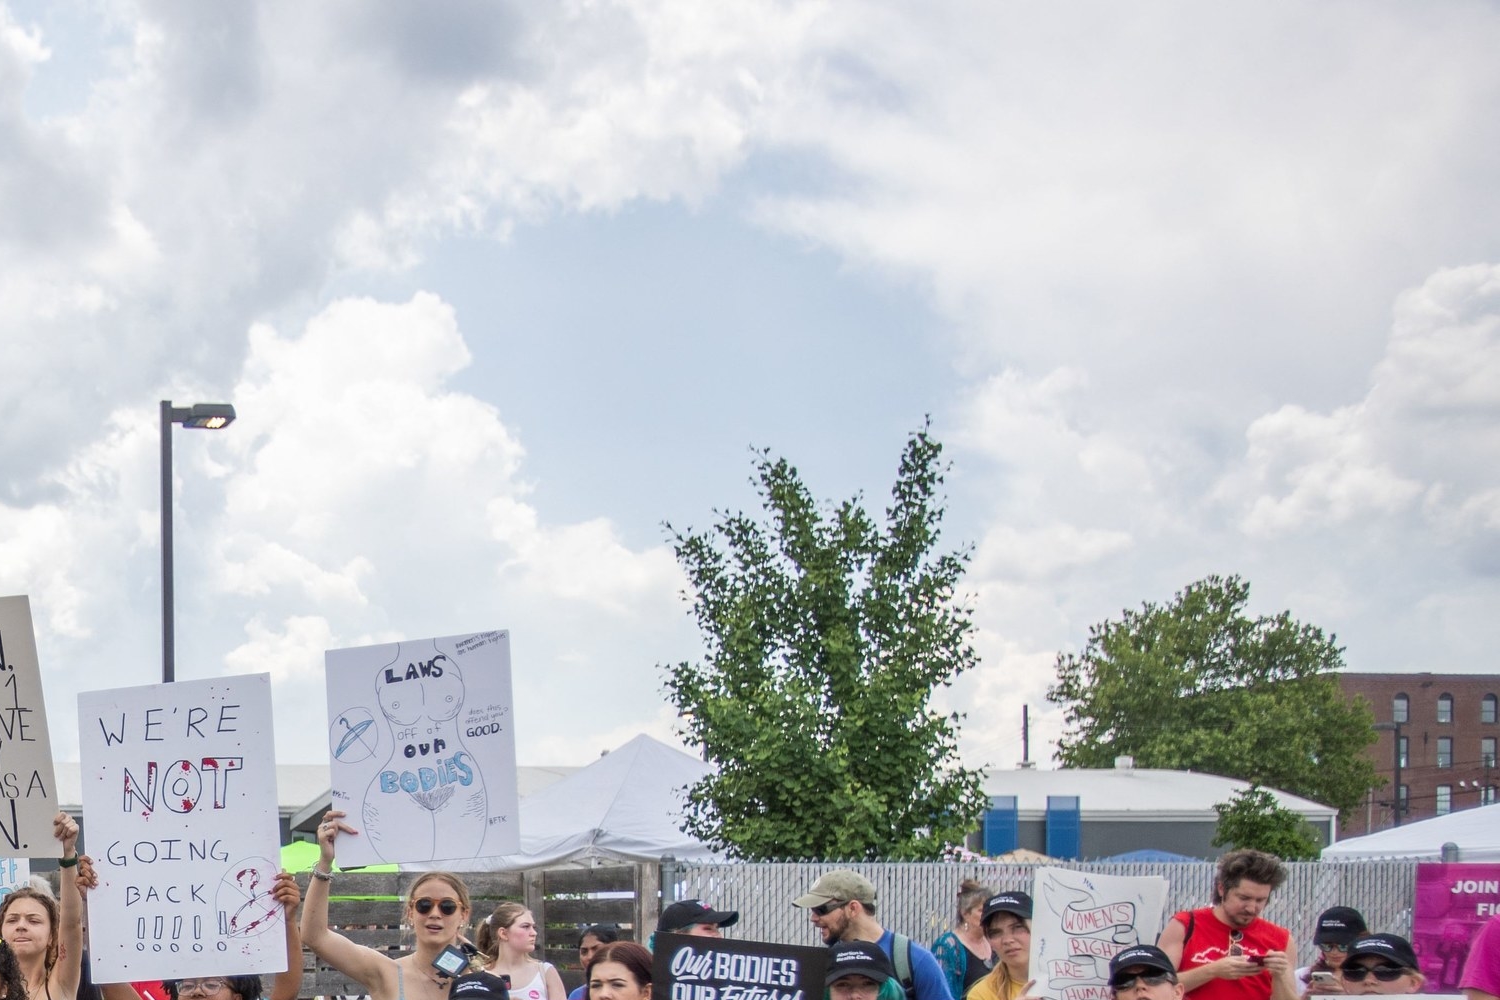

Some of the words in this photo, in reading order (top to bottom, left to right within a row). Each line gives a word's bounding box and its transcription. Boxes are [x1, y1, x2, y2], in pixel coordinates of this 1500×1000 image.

[385, 654, 447, 684] LAWS
[5, 673, 28, 711] 1
[98, 705, 241, 747] WE'RE
[466, 722, 503, 738] GOOD.
[26, 769, 48, 799] A
[123, 757, 244, 813] NOT
[106, 839, 230, 867] GOING
[125, 883, 208, 907] BACK
[1451, 880, 1500, 894] JOIN
[1064, 904, 1131, 931] WOMEN'S
[672, 946, 713, 980] Our
[714, 952, 798, 987] BODIES
[1055, 962, 1085, 978] ARE
